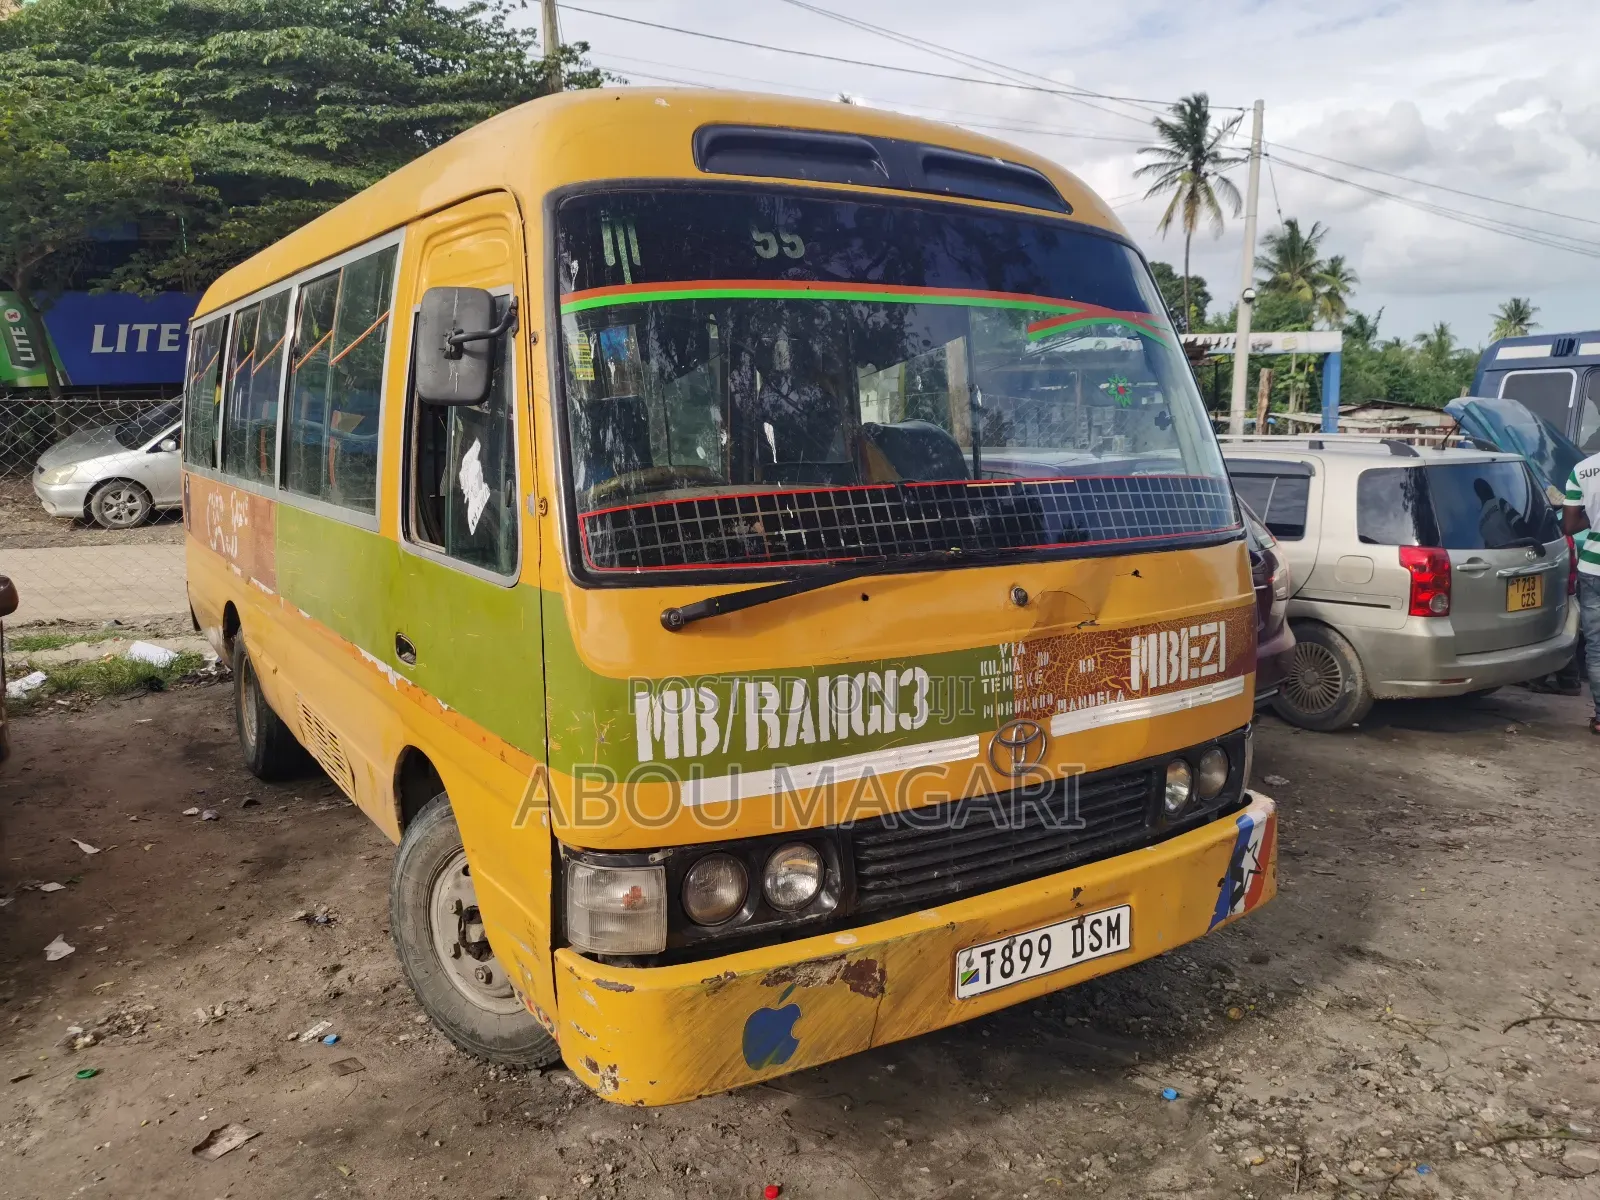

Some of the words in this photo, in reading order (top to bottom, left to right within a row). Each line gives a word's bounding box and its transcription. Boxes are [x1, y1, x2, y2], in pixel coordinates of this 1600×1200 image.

[9, 326, 36, 361] LITE
[1522, 576, 1536, 593] 713
[1521, 592, 1536, 608] CZS
[999, 640, 1026, 658] VIA
[1131, 620, 1226, 691] MBEZI
[980, 656, 1021, 677] KILWA
[980, 669, 1043, 695] TEMEKE
[1057, 689, 1125, 713] MANDELA
[980, 934, 1051, 985] T899
[1072, 912, 1121, 959] DSM
